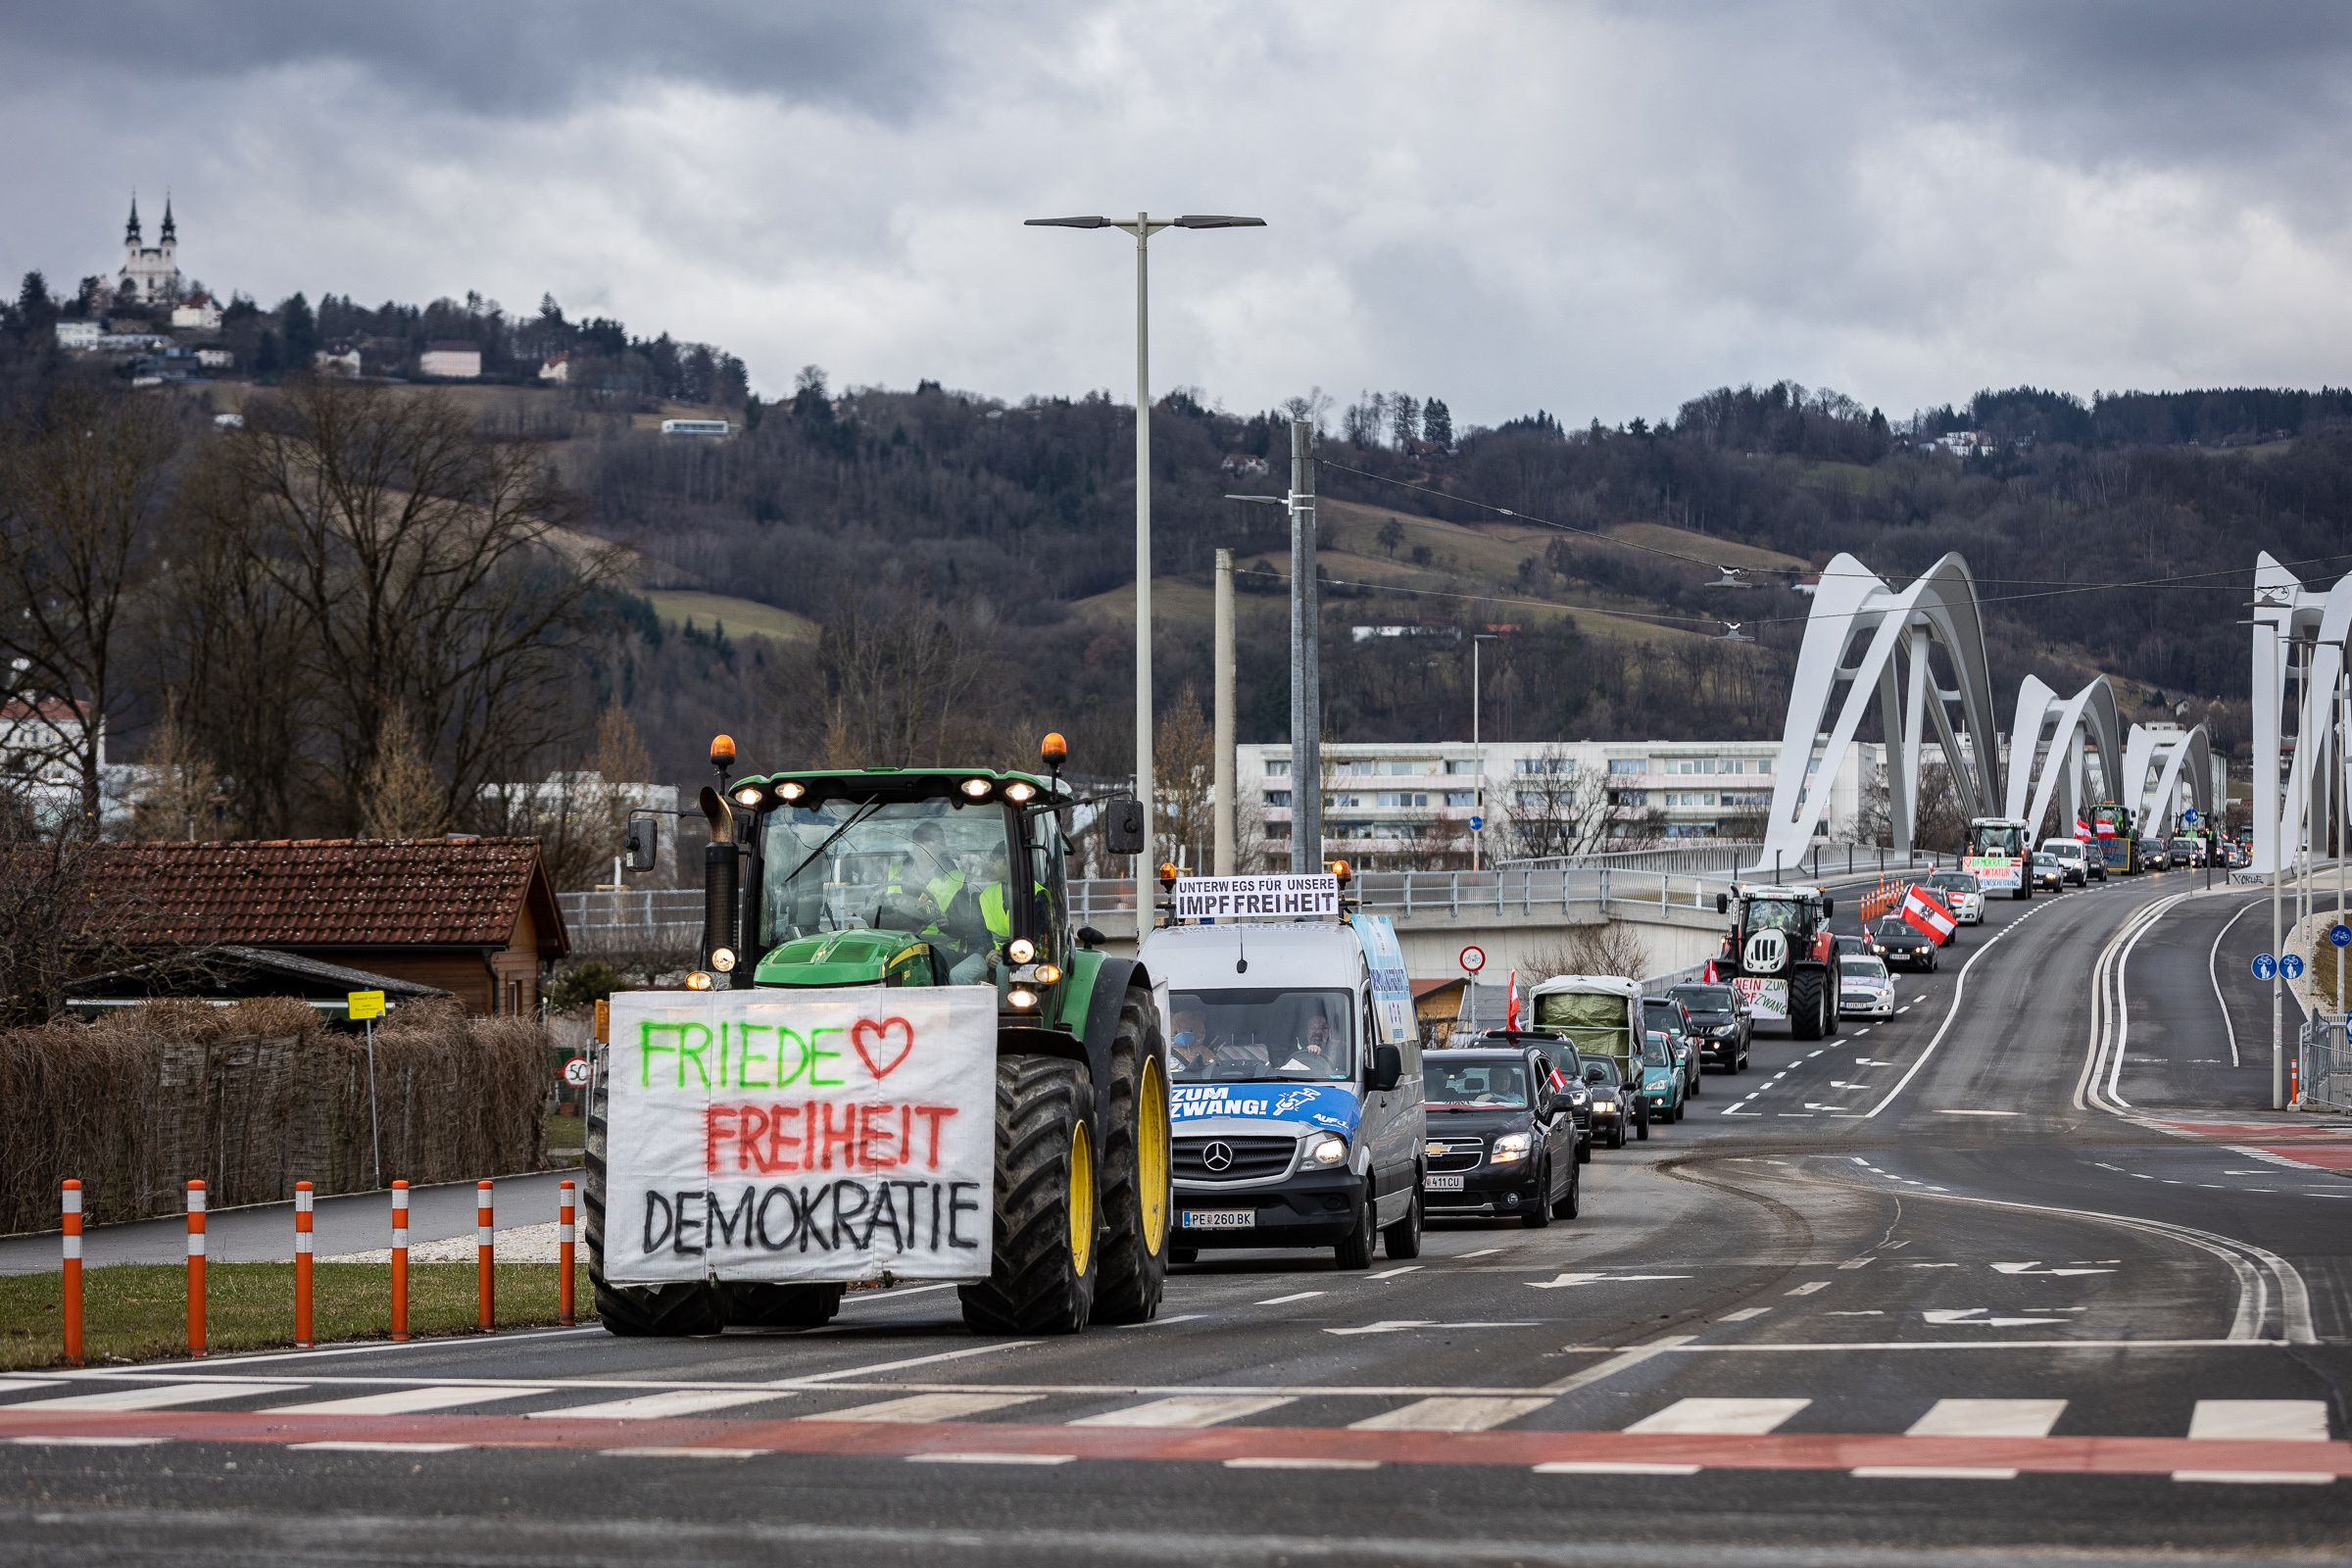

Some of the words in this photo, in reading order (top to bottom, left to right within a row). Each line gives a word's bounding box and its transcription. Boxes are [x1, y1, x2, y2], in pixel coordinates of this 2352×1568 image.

[1258, 878, 1282, 891] FÜR
[1287, 878, 1335, 891] UNSERE
[1736, 978, 1762, 991] NEIN
[640, 1020, 847, 1089] FRIEDE
[1171, 1087, 1229, 1102] ZUM
[1170, 1100, 1269, 1118] ZWANG!
[707, 1102, 958, 1173] FREIHEIT
[643, 1181, 979, 1254] DEMOKRATIE
[1192, 1214, 1206, 1225] PE
